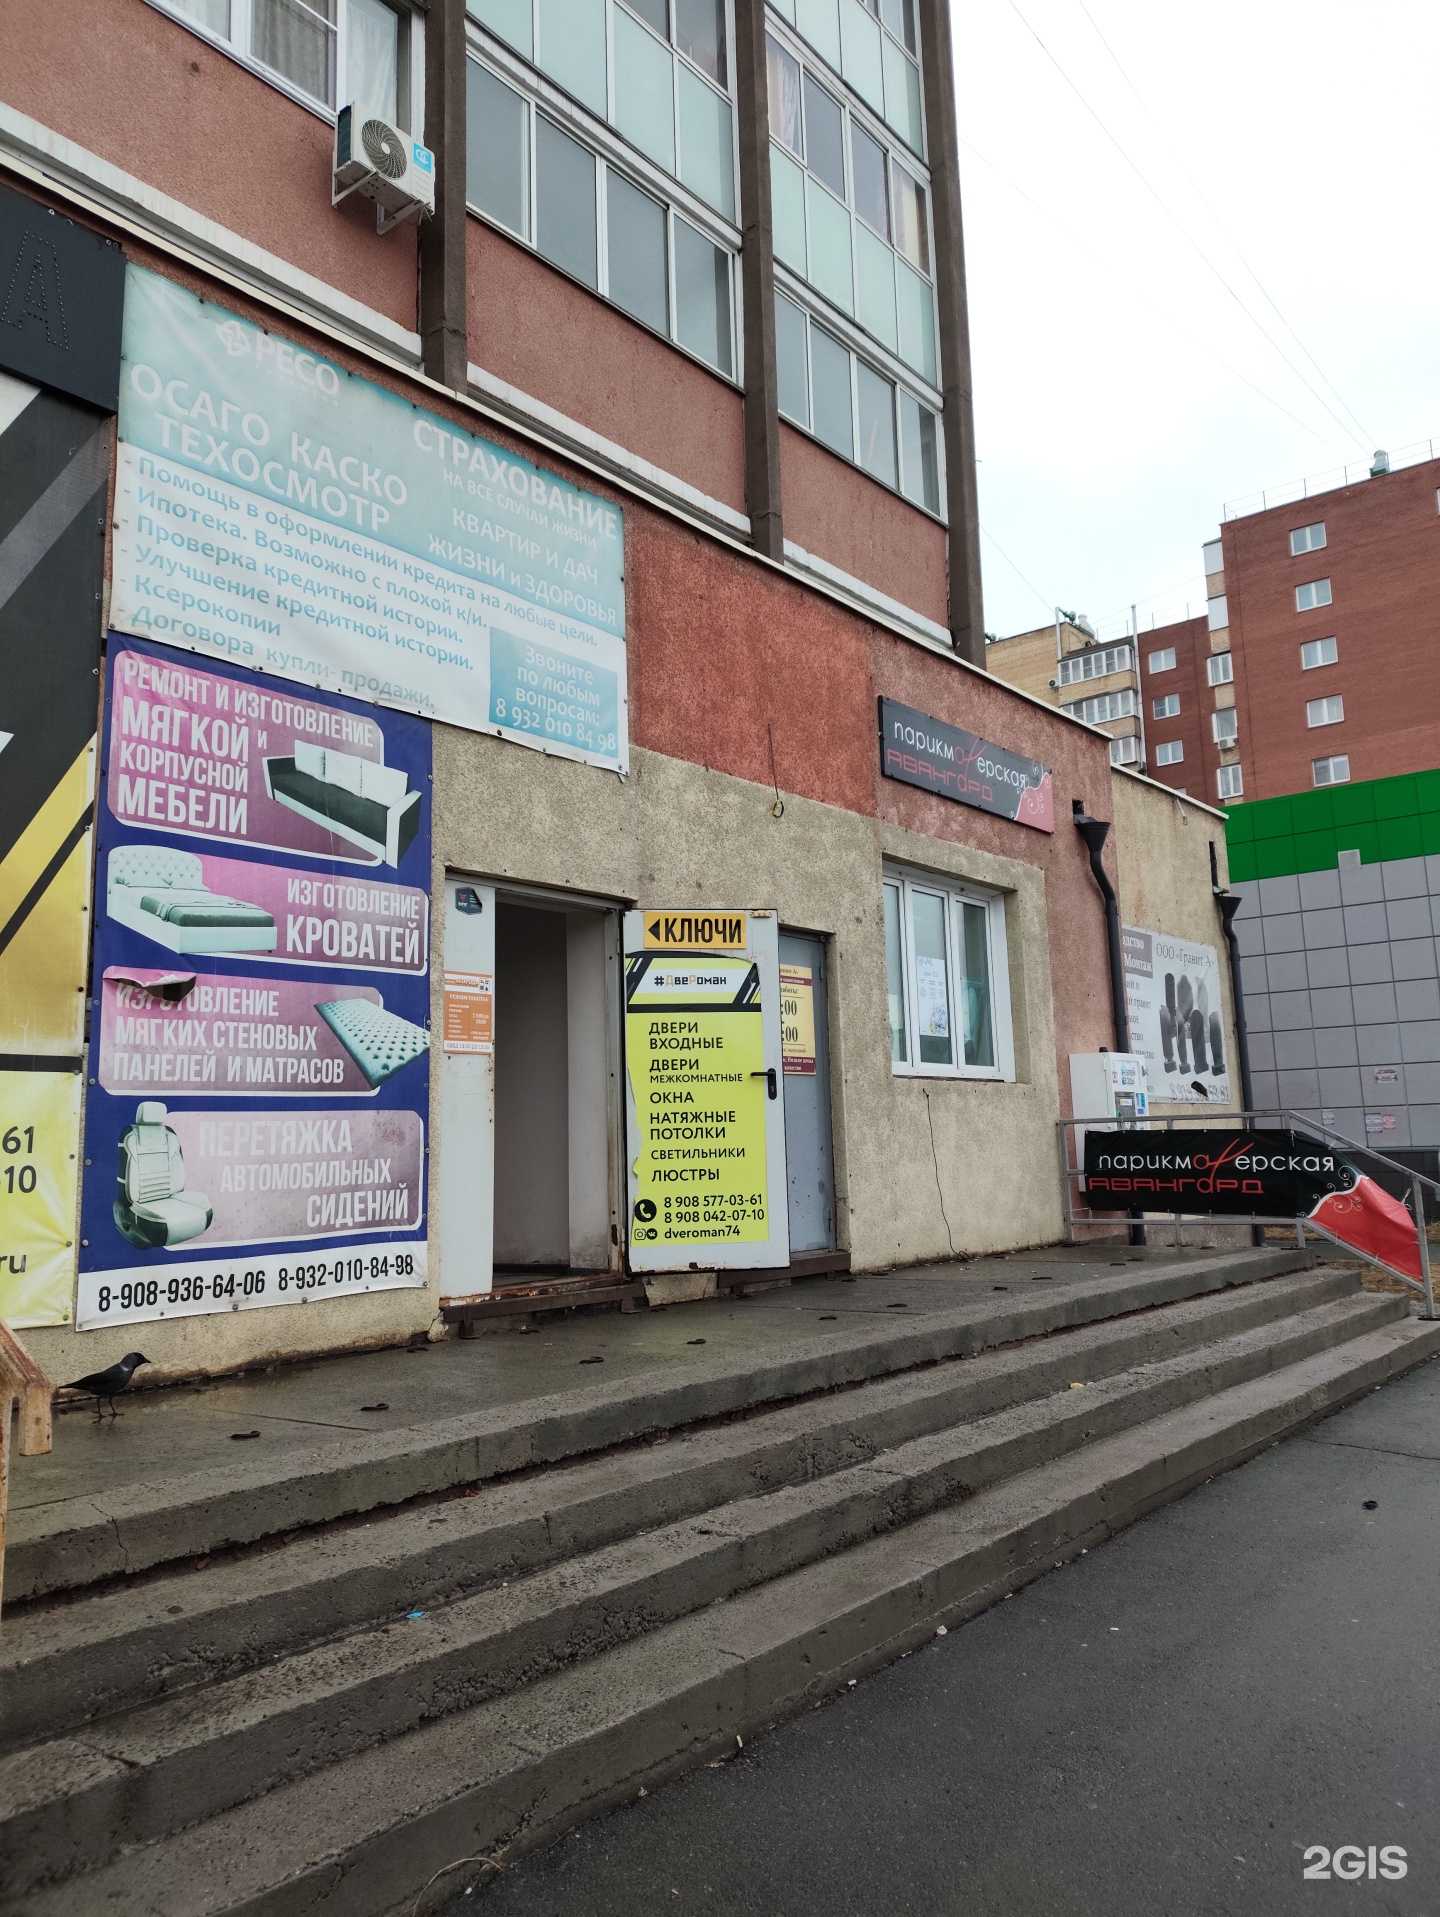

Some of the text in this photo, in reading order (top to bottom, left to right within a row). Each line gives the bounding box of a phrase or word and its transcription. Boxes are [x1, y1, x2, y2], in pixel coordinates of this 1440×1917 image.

[130, 363, 271, 447] ОСАГО
[290, 431, 408, 505] КАСКО
[155, 411, 390, 532] ТЕХОСМОТР
[412, 419, 618, 541] СТРАХОВАНИЕ
[137, 456, 242, 513] Помощь
[247, 504, 259, 518] в
[264, 510, 399, 572] оформлении
[402, 562, 477, 601] кредита
[481, 592, 501, 608] на
[452, 507, 542, 560] КВАРТИР
[563, 557, 600, 585] ДАЧ
[136, 514, 464, 644] Проверка кредитной истории.
[255, 530, 367, 585] Возможно
[386, 580, 453, 616] плохой
[428, 534, 506, 584] ЖИЗНИ
[524, 573, 618, 626] ЗДОРОВЬЯ
[134, 574, 282, 637] Ксерокопии
[134, 543, 473, 671] Улучшение кредитной истории.
[131, 605, 255, 657] Договора
[517, 667, 600, 706] по любым
[525, 645, 593, 685] Звоните
[122, 657, 374, 748] РЕМОНТ И ИЗГОТОВЛЕНИЕ
[121, 695, 250, 763] МЯГКОЙ
[496, 698, 617, 753] 8 932 010 84 98
[120, 740, 249, 794] КОРПУСНОЙ
[117, 774, 248, 835] МЕБЕЛИ
[287, 877, 420, 921] ИЗГОТОВЛЕНИЕ
[286, 913, 420, 965] КРОВАТЕЙ
[664, 917, 742, 944] КЛЮЧИ
[115, 1015, 319, 1052] МЯГКИХ СТЕНОВЫХ
[649, 1021, 698, 1036] ДВЕРИ
[649, 1036, 724, 1051] ВХОДНЫЕ
[113, 1050, 345, 1084] ПАНЕЛЕЙ И МАТРАСОВ
[649, 1058, 699, 1073] ДВЕРИ
[650, 1073, 743, 1084] МЕЖКОМНАТНЫЕ
[650, 1091, 694, 1104] ОКНА
[650, 1110, 736, 1125] НАТЯЖНЫЕ
[200, 1118, 353, 1158] ПЕРЕТЯЖКА
[650, 1126, 726, 1140] ПОТОЛКИ
[650, 1147, 746, 1160] СВЕТИЛЬНИКИ
[219, 1158, 393, 1194] АВТОМОБИЛЬНЫХ
[651, 1168, 720, 1183] ЛЮСТРЫ
[306, 1183, 409, 1228] СИДЕНИЙ
[664, 1193, 763, 1208] 8 908 577-03-61
[664, 1208, 765, 1223] 8 908 042-07-10
[664, 1225, 741, 1239] dveroman74
[97, 1253, 415, 1313] 8-908-936-64-06 8-932-010-84-98
